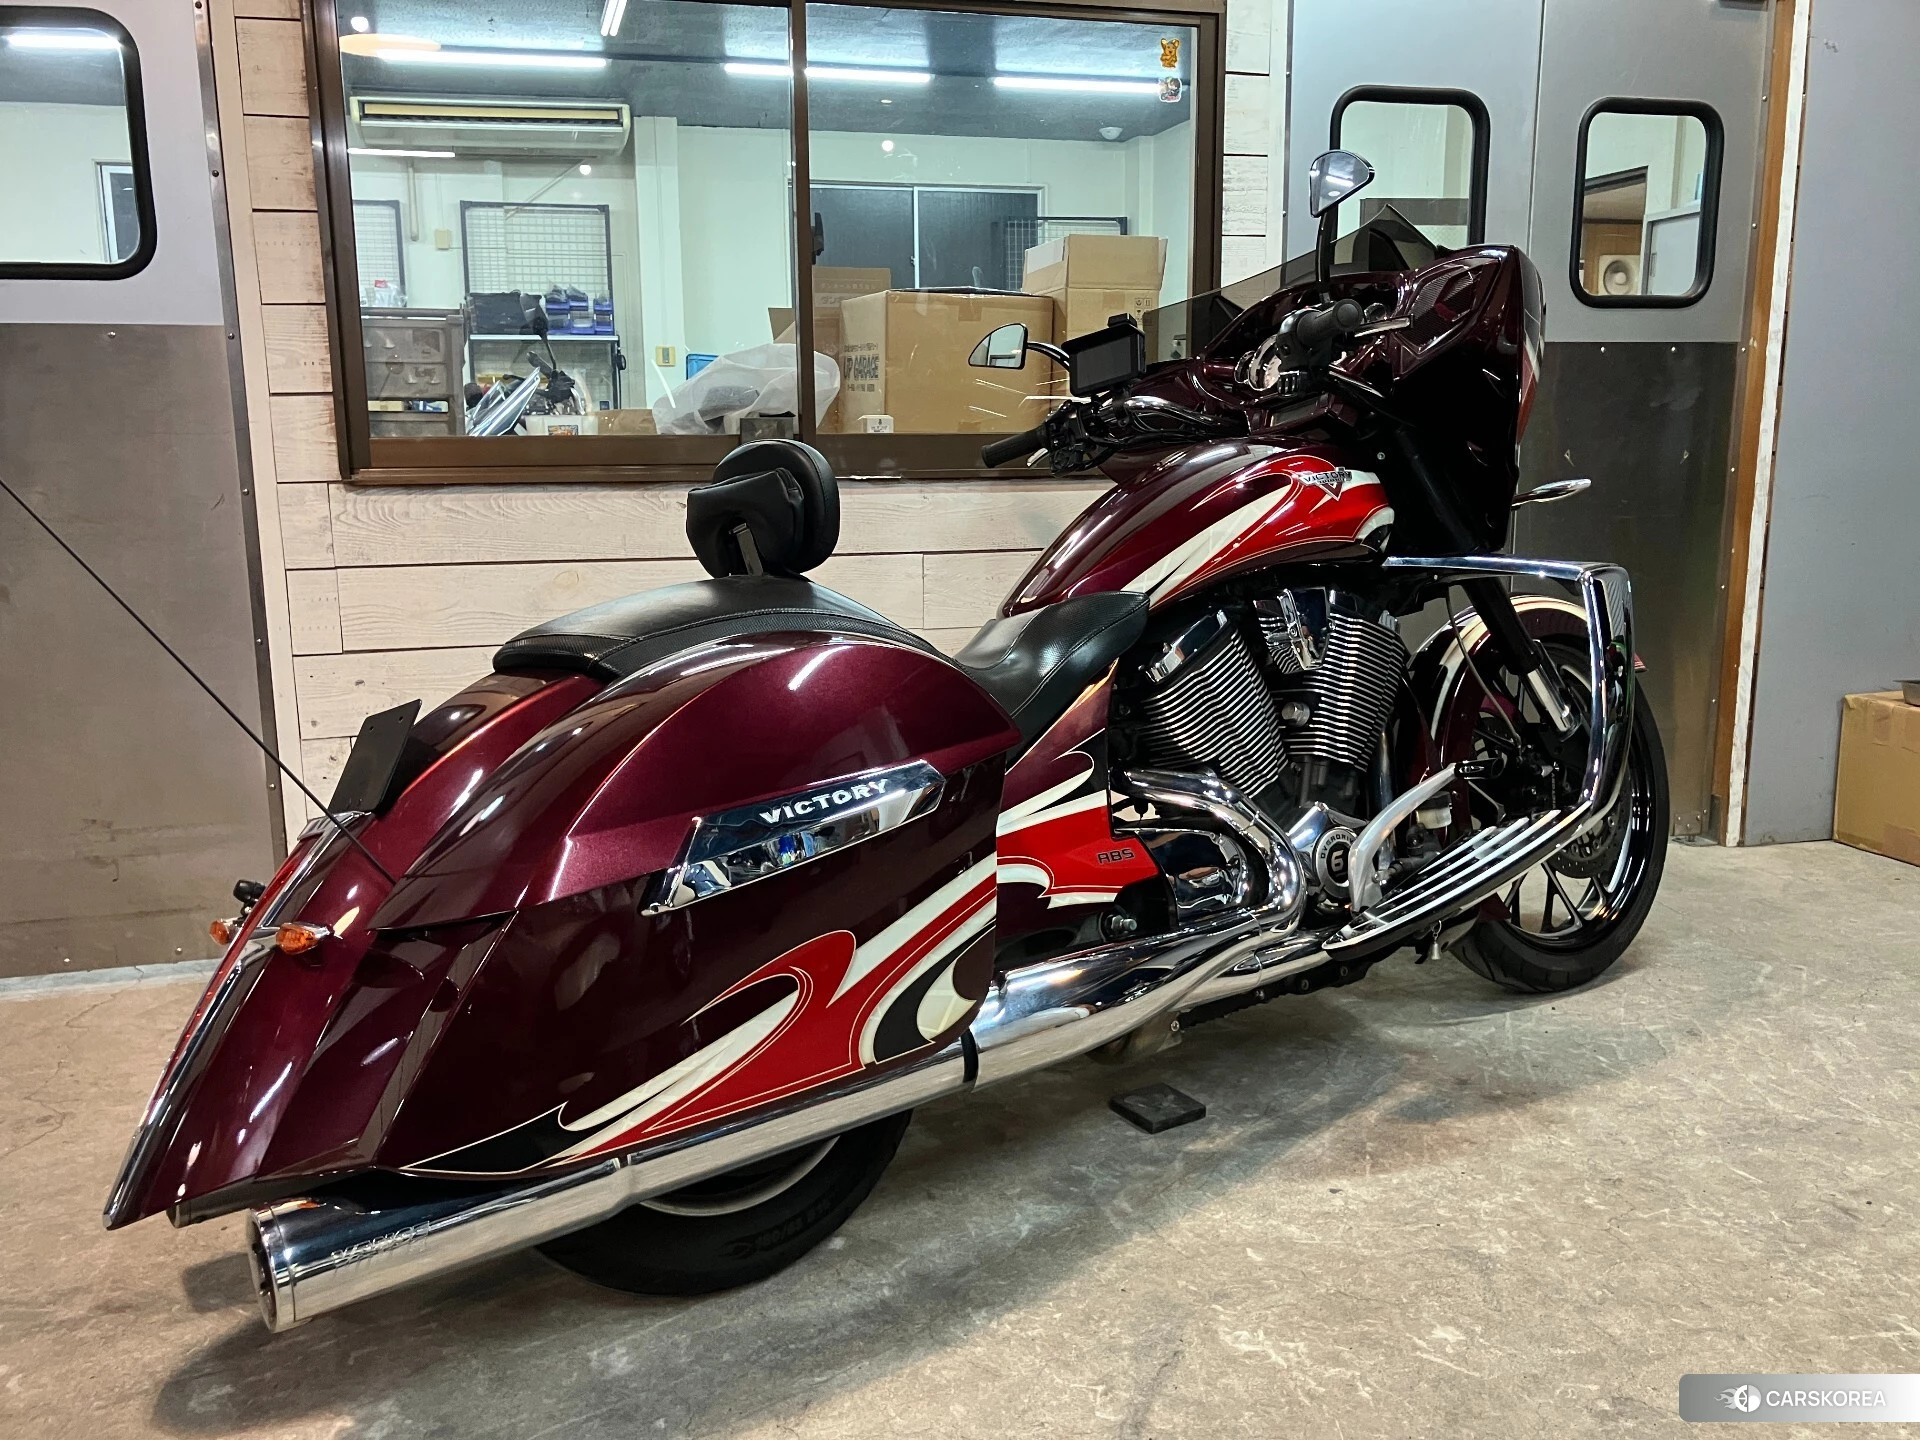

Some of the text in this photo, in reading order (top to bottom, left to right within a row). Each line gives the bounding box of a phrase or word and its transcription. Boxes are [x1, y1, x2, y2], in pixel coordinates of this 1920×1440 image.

[1303, 469, 1352, 483] VICTORY
[759, 778, 888, 824] VICTORY
[1097, 847, 1135, 865] ABS
[1320, 833, 1356, 859] OVERDRIV
[1331, 849, 1344, 872] 6
